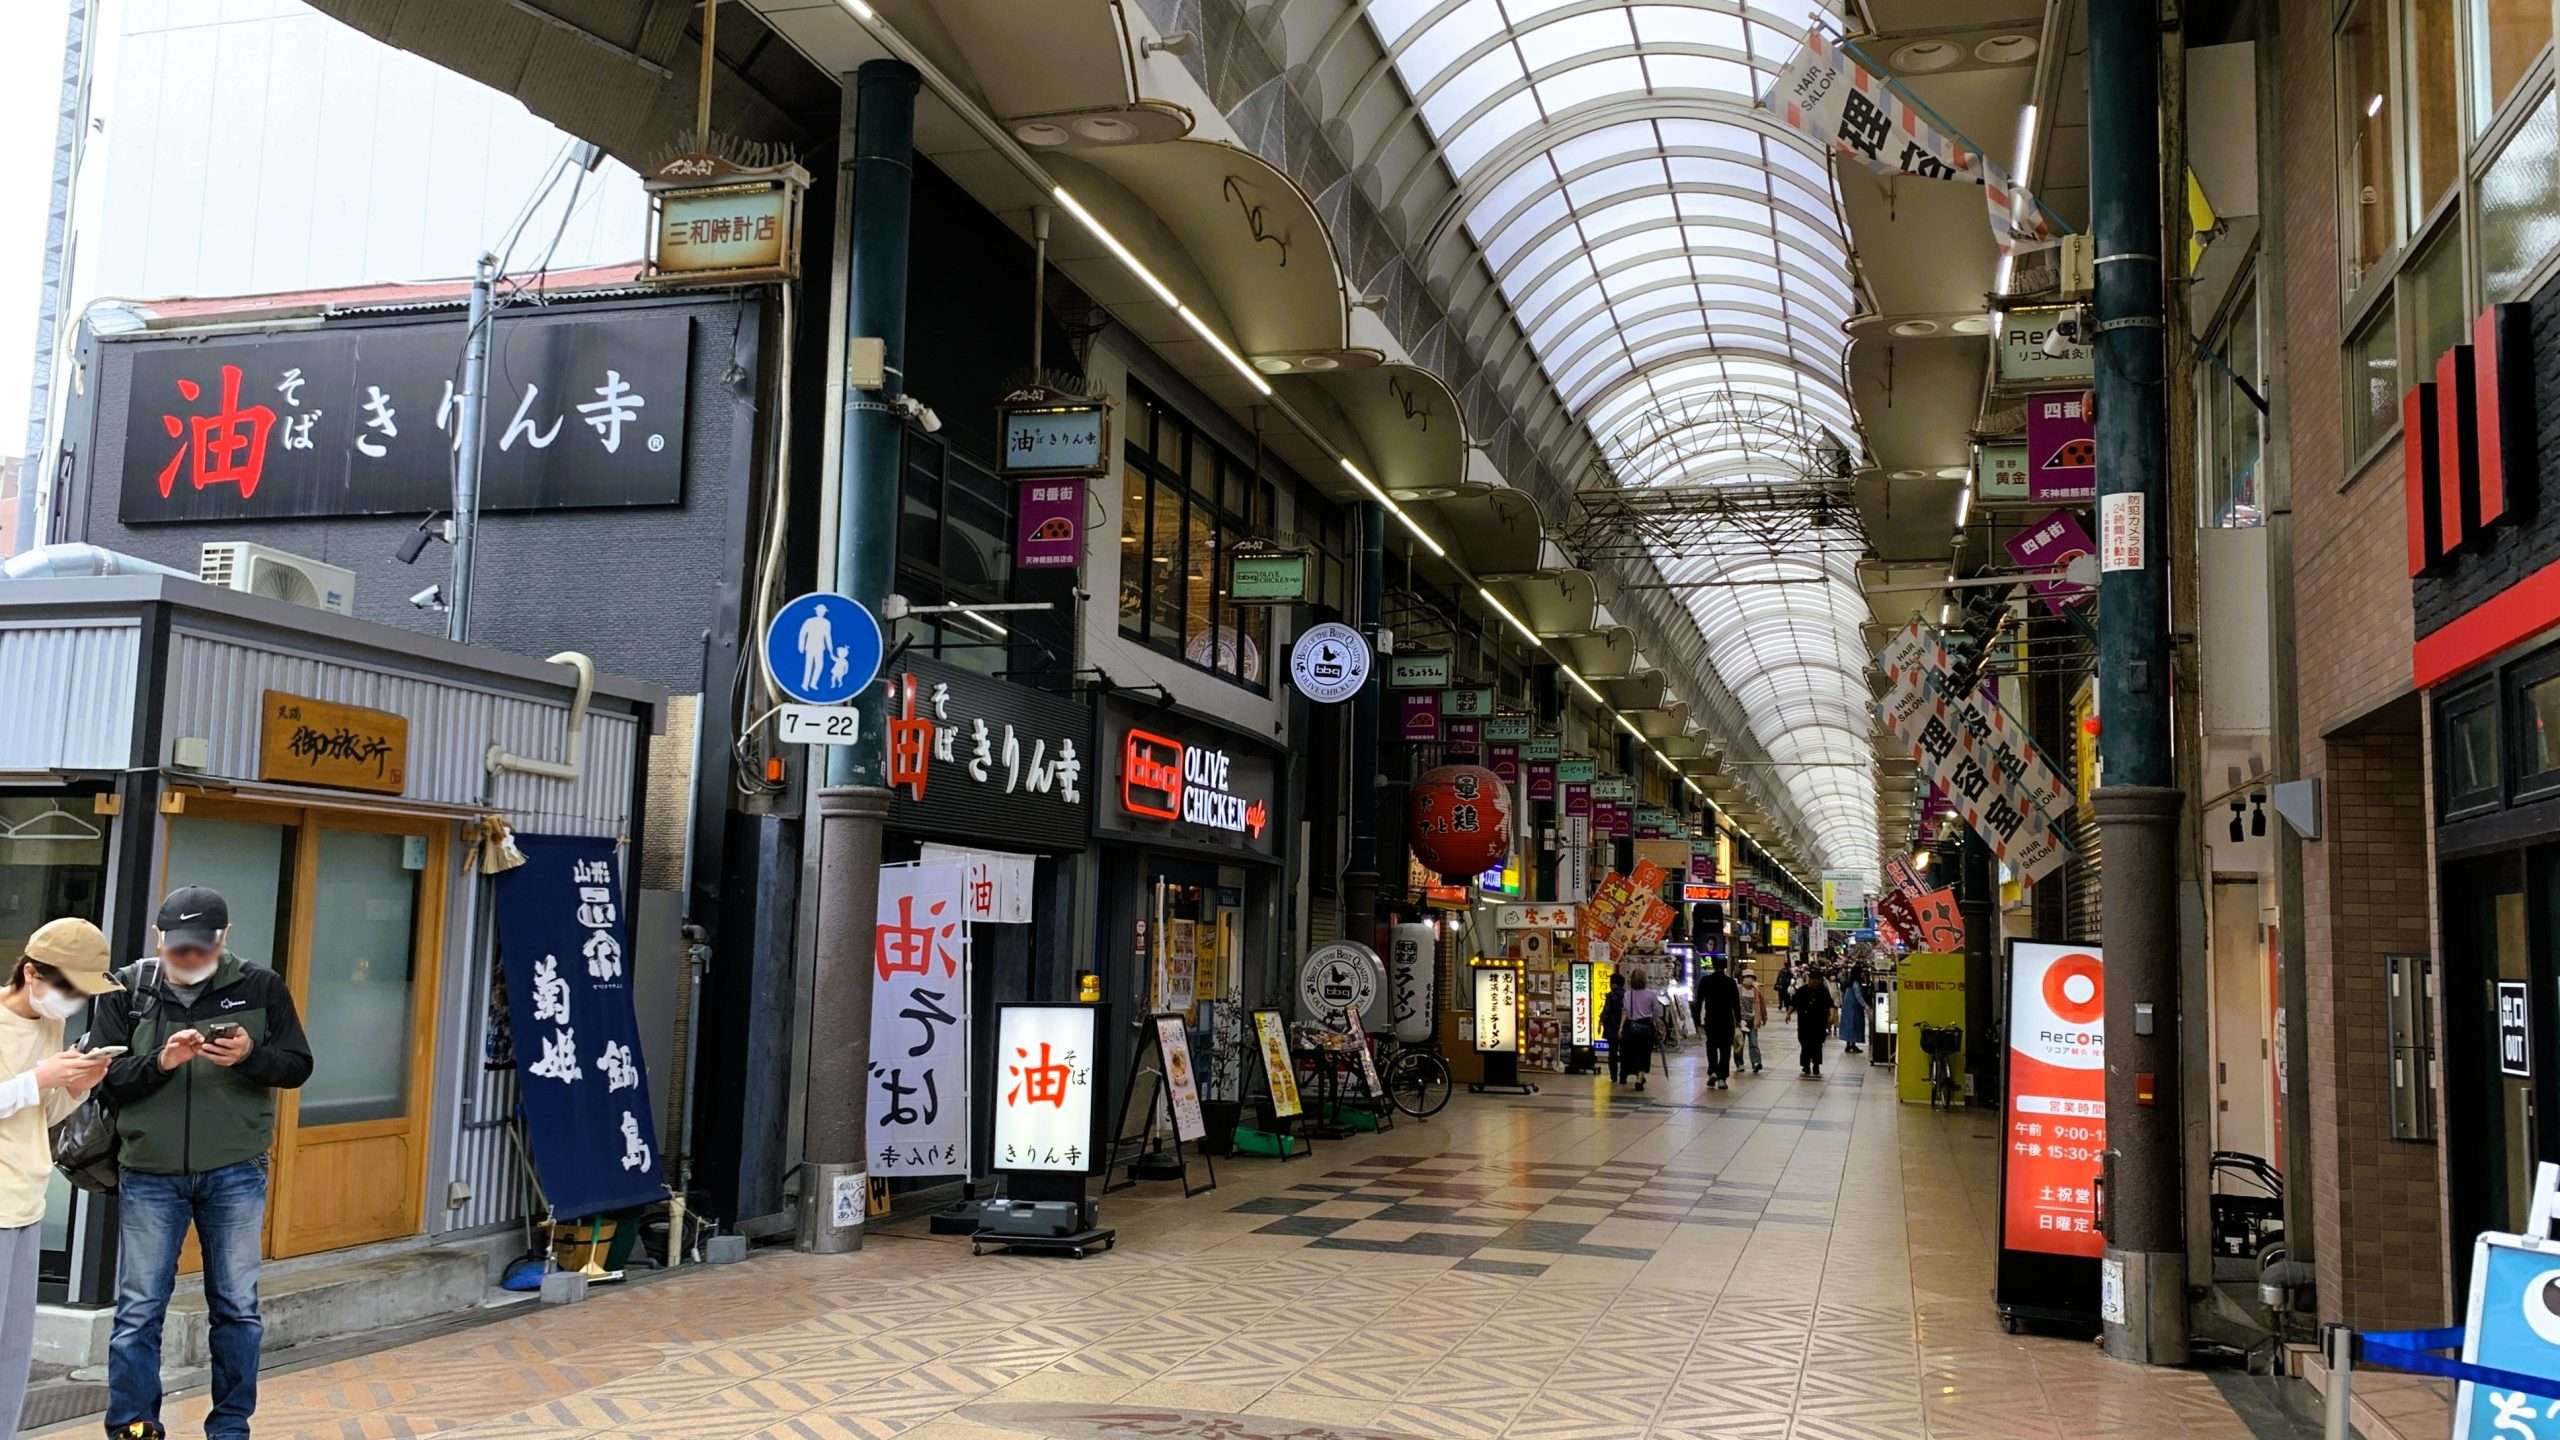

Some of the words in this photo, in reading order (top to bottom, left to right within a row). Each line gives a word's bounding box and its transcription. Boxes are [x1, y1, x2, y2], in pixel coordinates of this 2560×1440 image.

[1793, 65, 1822, 96] HAIR
[1801, 68, 1838, 112] SALON
[1837, 87, 1985, 185] 理容
[667, 214, 776, 246] 三和時計店
[2009, 329, 2051, 346] Re
[2044, 402, 2083, 419] 四番
[1032, 487, 1073, 502] 四番街
[2021, 521, 2066, 556] 四番街
[2128, 495, 2141, 567] 防犯カメラ設置
[1896, 642, 1916, 662] HAIR
[1894, 692, 1916, 712] HAIR
[1898, 696, 1926, 722] SALON
[1184, 746, 1231, 792] OLIVE
[1917, 713, 2025, 845] 理容室
[1183, 785, 1247, 833] CHICKEN
[2019, 840, 2041, 859] HAIR
[2022, 846, 2053, 870] SALON
[970, 863, 993, 917] 油
[1394, 966, 1416, 1023] ラーメン
[2502, 995, 2525, 1028] 出口
[2505, 1034, 2523, 1062] OUT
[596, 1039, 651, 1173] 鍋島
[2049, 1100, 2104, 1115] 営業時間
[2015, 1122, 2042, 1137] 午前
[1004, 1144, 1082, 1166] きりん寺
[2014, 1142, 2042, 1157] 午後
[2040, 1186, 2103, 1205] 土祝営
[2039, 1215, 2102, 1234] 日曜定
